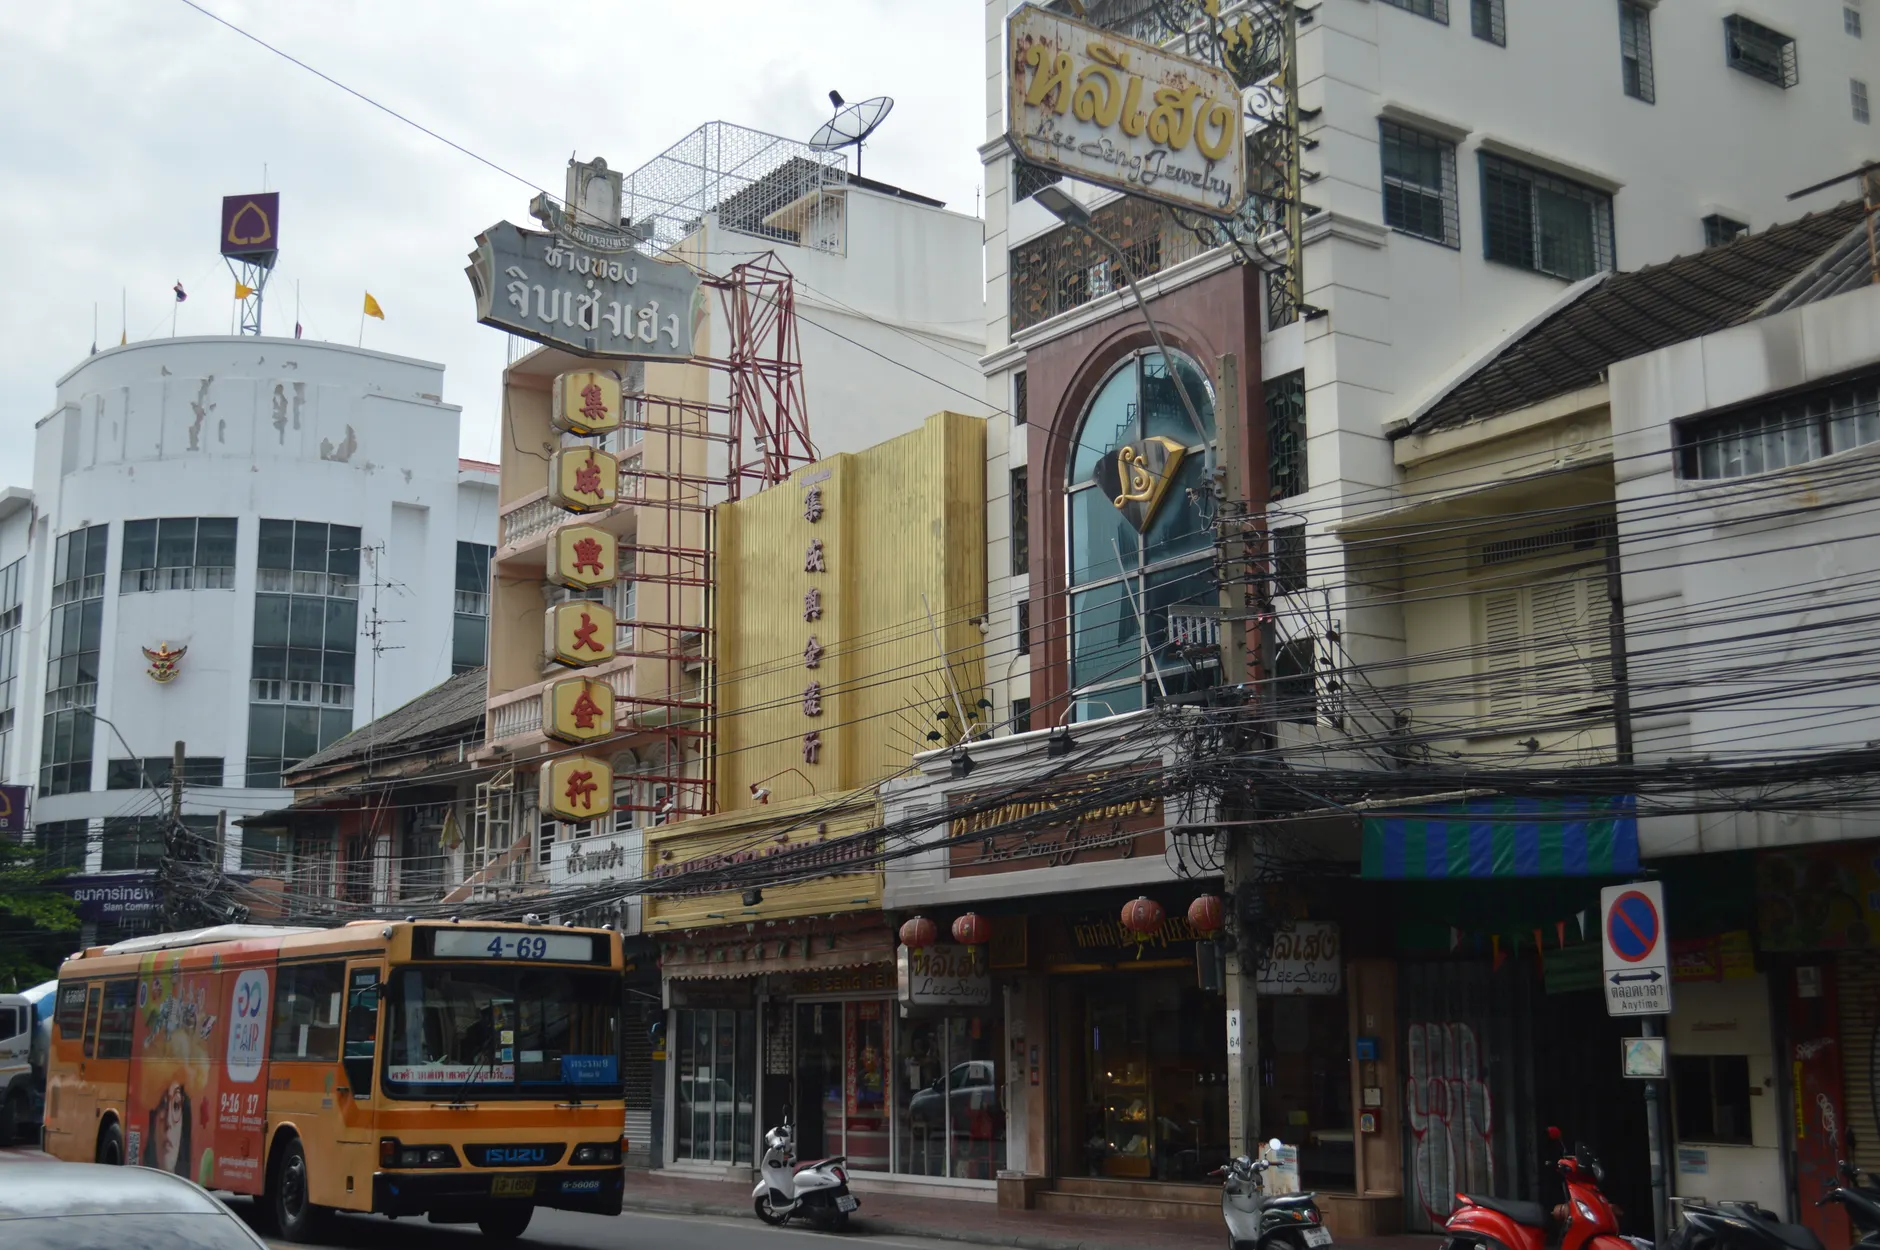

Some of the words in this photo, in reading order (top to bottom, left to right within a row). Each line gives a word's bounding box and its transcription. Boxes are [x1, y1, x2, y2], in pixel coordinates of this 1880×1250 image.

[1026, 119, 1077, 152] Lee
[1078, 135, 1142, 183] Seng
[1140, 149, 1232, 208] Jewelry
[545, 239, 638, 285] ห้างทอง
[103, 903, 123, 912] Siam
[486, 936, 547, 960] 4-69
[1258, 961, 1293, 983] Lee
[1293, 961, 1338, 993] Seng
[915, 977, 948, 996] Lee
[948, 978, 989, 1004] Seng
[1610, 983, 1664, 1000] ตลอดเวลา
[1621, 999, 1659, 1012] Anytime
[1229, 1037, 1241, 1048] 64
[220, 1092, 240, 1113] 9-16
[246, 1093, 259, 1115] 17
[485, 1147, 546, 1163] ISUZU
[562, 1179, 600, 1189] 6-56068
